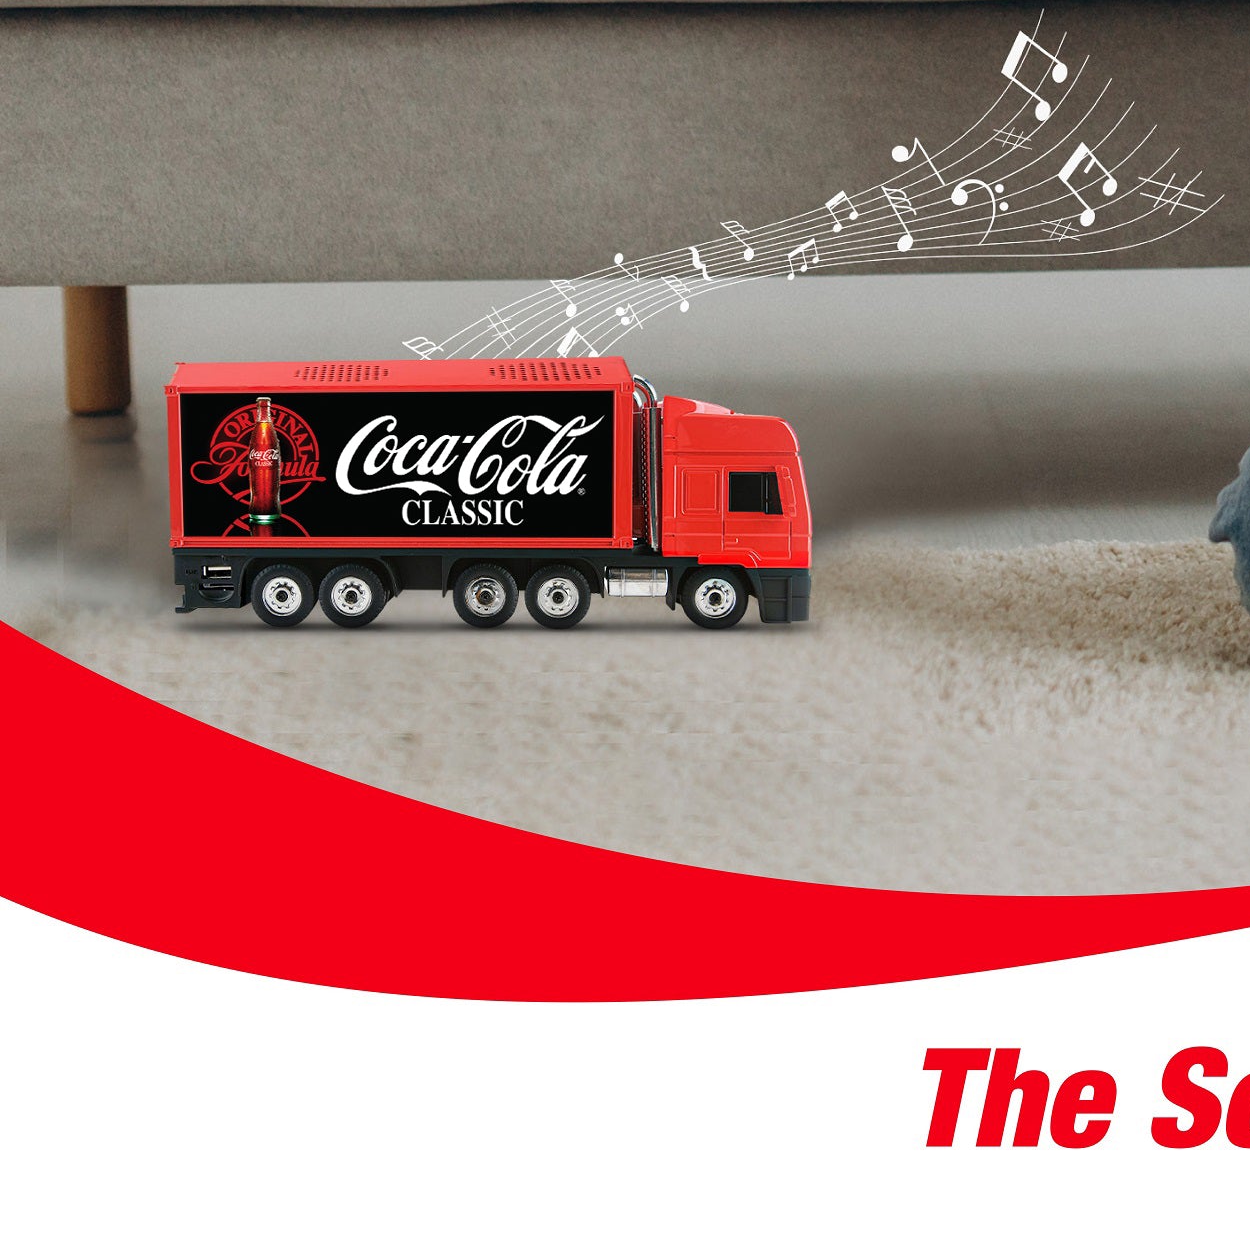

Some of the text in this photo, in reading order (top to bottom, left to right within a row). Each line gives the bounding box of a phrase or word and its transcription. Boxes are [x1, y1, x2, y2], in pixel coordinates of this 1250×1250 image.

[190, 441, 327, 485] Foula
[336, 414, 605, 496] Coca-Cola
[402, 500, 524, 525] CLASSIC
